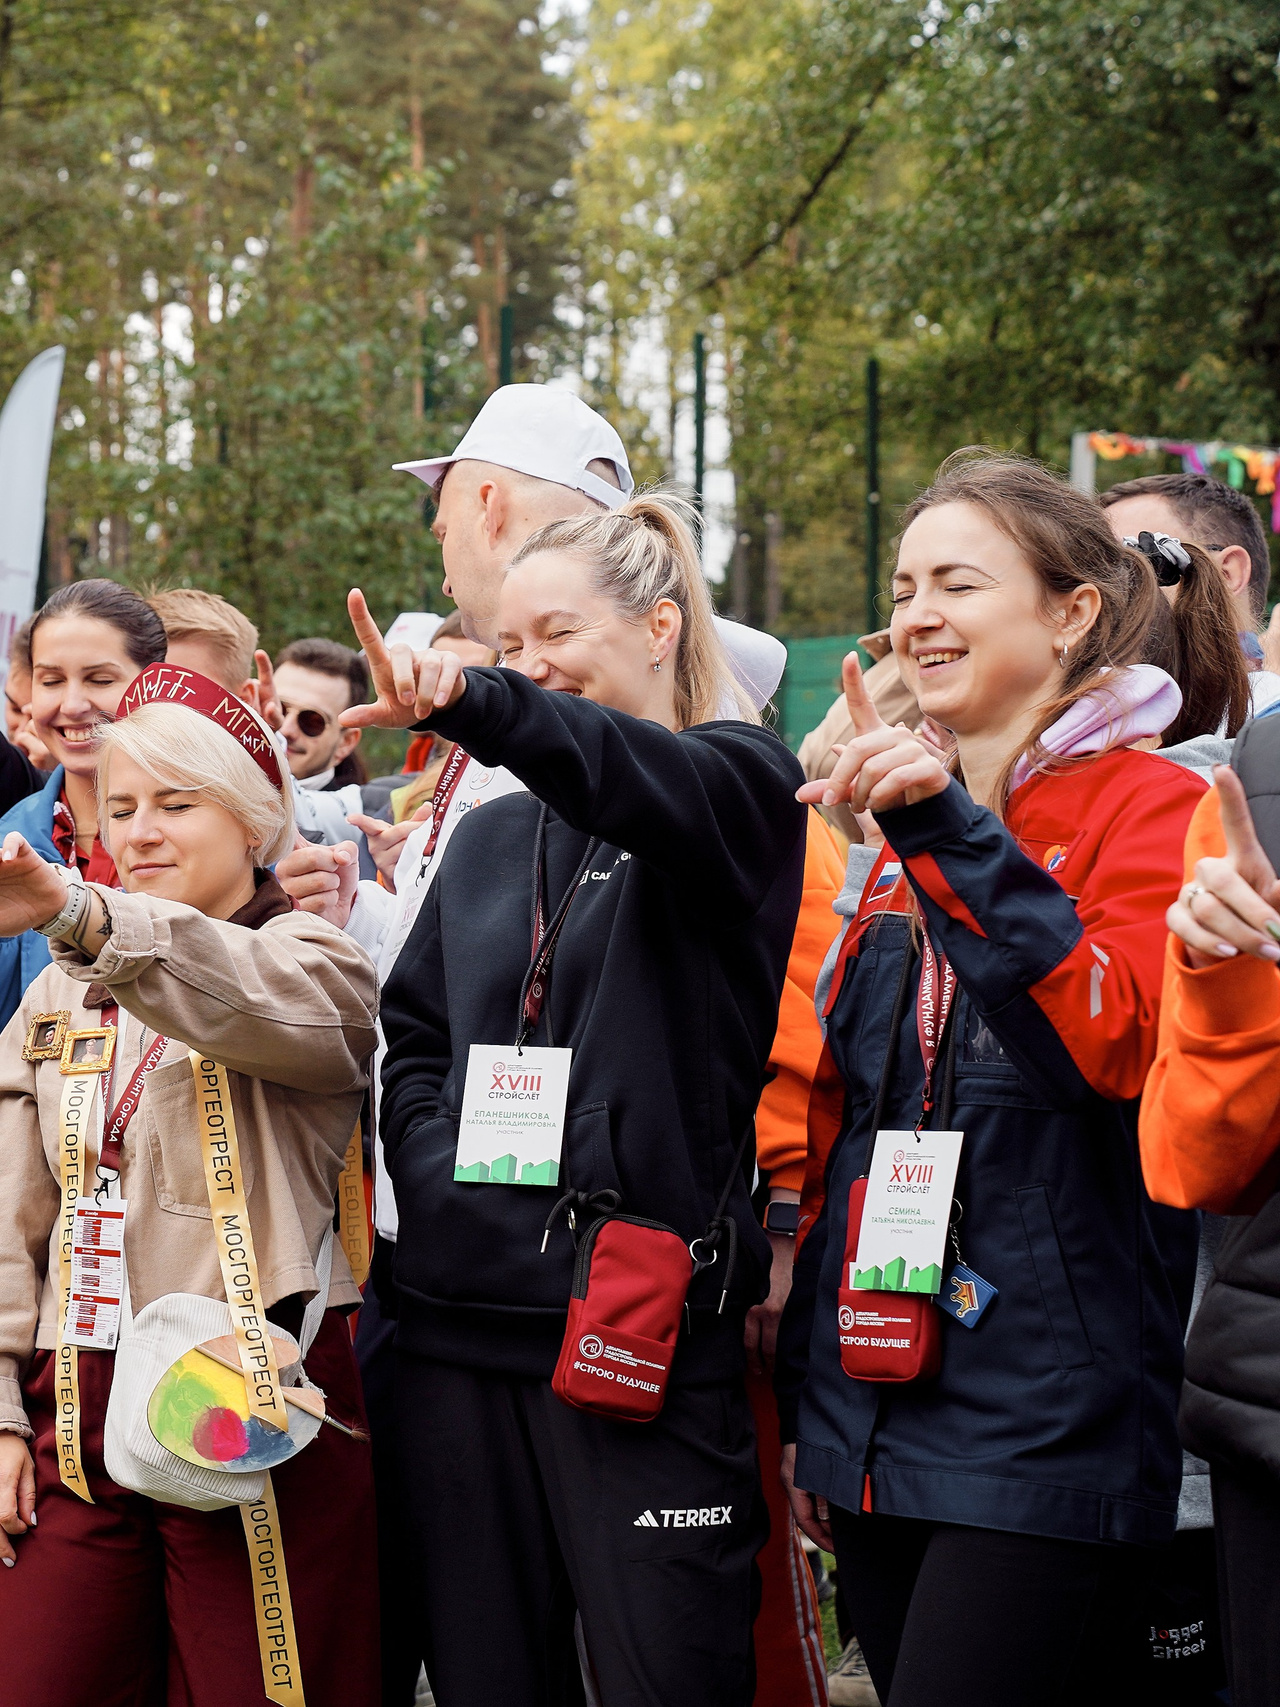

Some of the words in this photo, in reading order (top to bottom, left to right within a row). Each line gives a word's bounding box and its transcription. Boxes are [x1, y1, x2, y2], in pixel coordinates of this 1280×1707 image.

[922, 967, 934, 1037] ФУНДАМЕНТ
[490, 1074, 541, 1091] XVIII
[488, 1091, 540, 1100] СТРОЙСЛЁТ
[108, 1098, 135, 1142] ГОРОДА
[474, 1110, 550, 1120] ЕПАНЕШНИКОВА
[889, 1164, 934, 1183] XVIII
[887, 1184, 930, 1194] СТРОЙСЛЁТ
[888, 1207, 921, 1216] СЕМИНА
[221, 1214, 276, 1410] МОСГОРГЕОТРЕСТ
[870, 1337, 911, 1349] БУДУЩЕЕ
[573, 1360, 615, 1380] #СТРОЮ
[616, 1373, 661, 1394] БУДУЩЕЕ
[660, 1506, 732, 1528] TERREX
[1149, 1620, 1204, 1645] Jogger
[1152, 1638, 1206, 1660] Street
